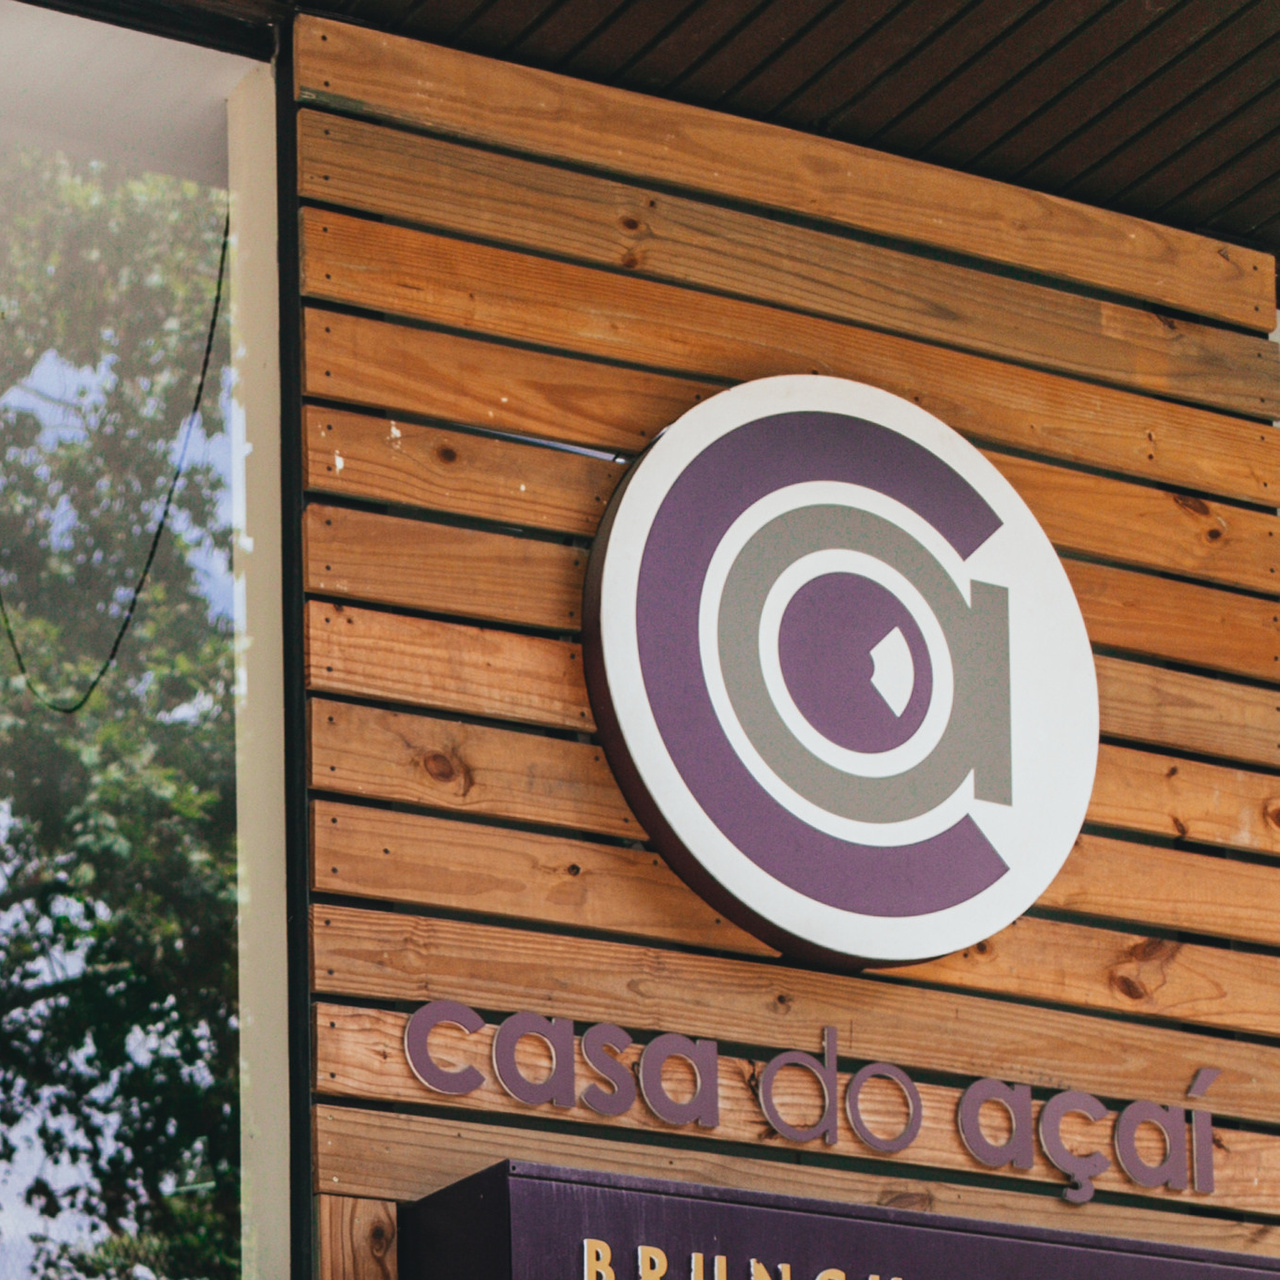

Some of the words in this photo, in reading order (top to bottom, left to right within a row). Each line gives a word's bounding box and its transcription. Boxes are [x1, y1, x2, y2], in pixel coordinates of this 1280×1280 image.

[403, 1000, 719, 1128] casa
[757, 1027, 923, 1154] do
[958, 1067, 1220, 1204] açaí
